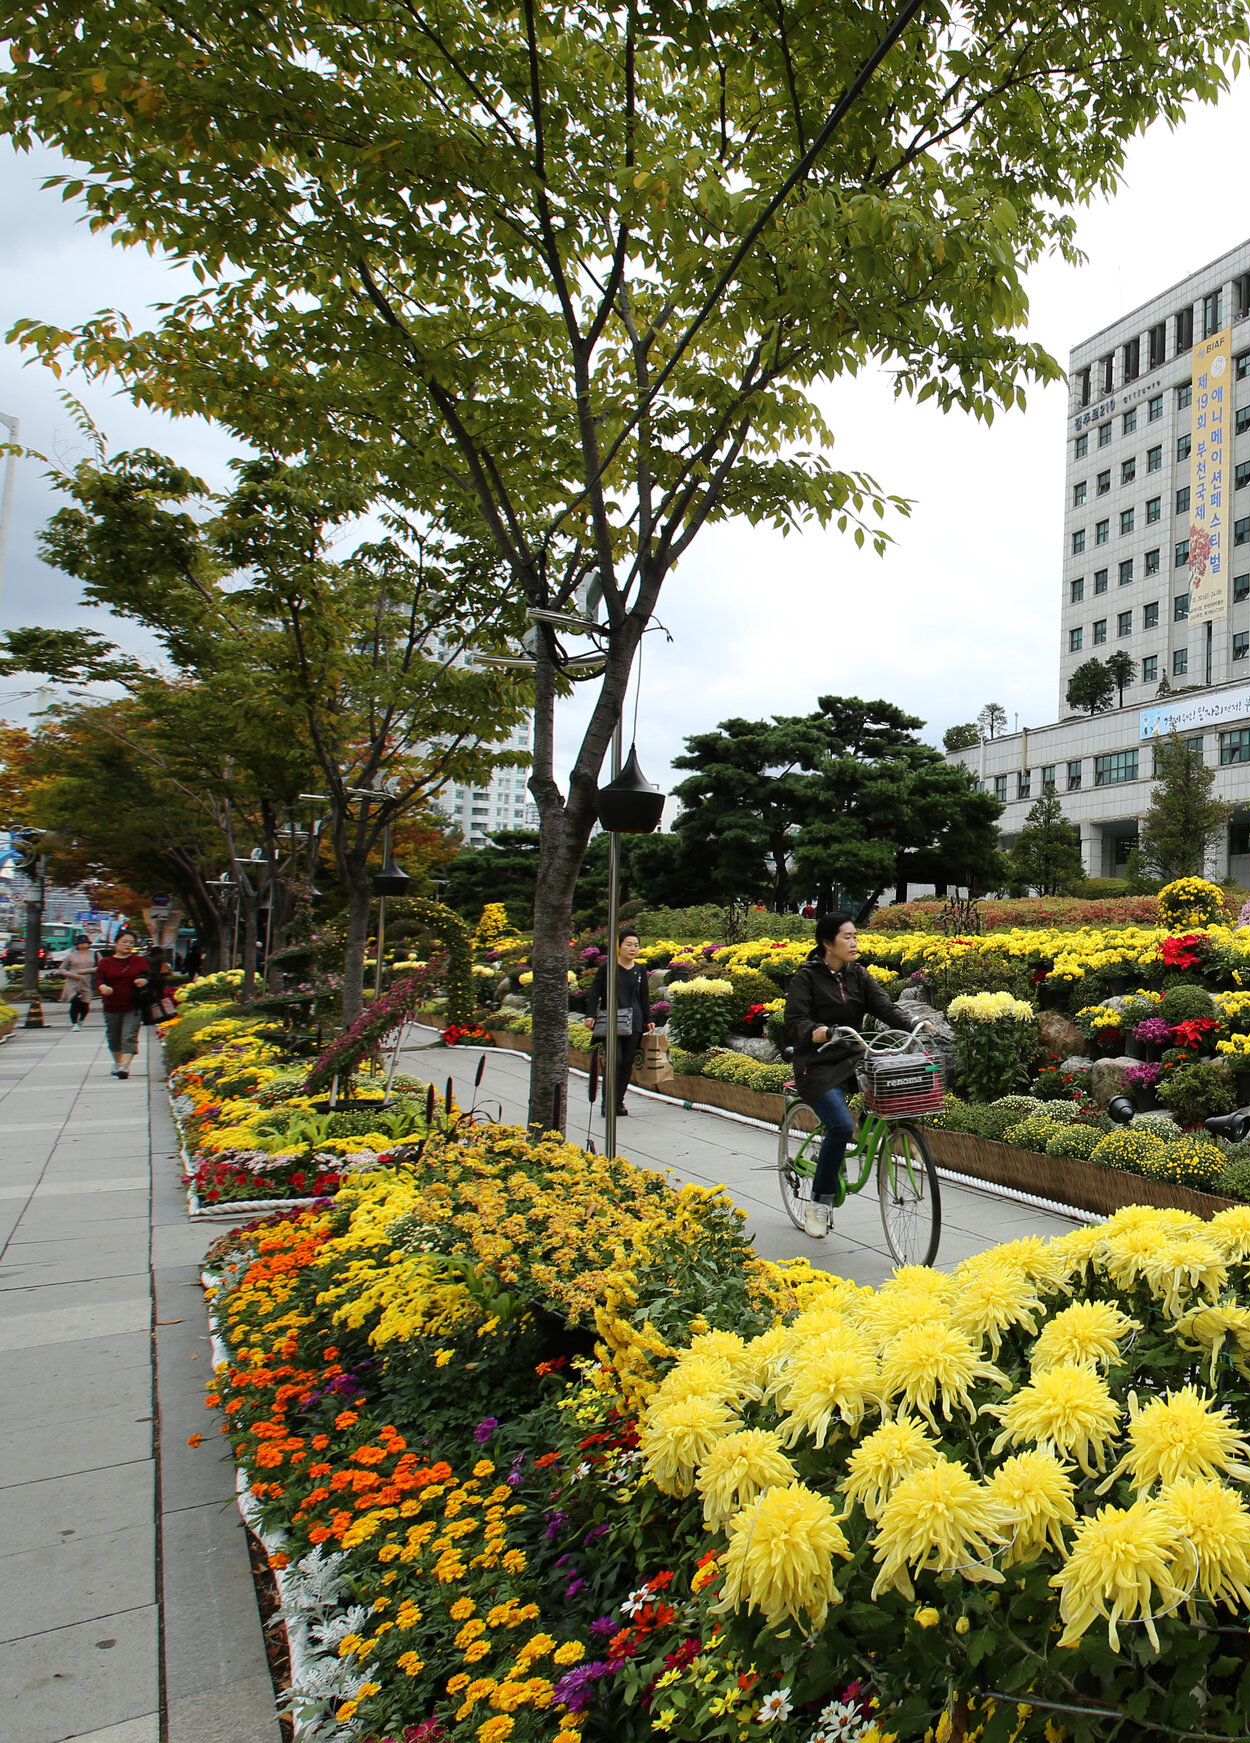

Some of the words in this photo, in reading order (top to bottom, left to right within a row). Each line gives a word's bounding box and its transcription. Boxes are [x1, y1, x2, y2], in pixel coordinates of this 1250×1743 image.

[1206, 336, 1225, 354] BIAF
[1195, 440, 1207, 520] 부천국제
[1209, 386, 1223, 574] 애니메이션페스티벌
